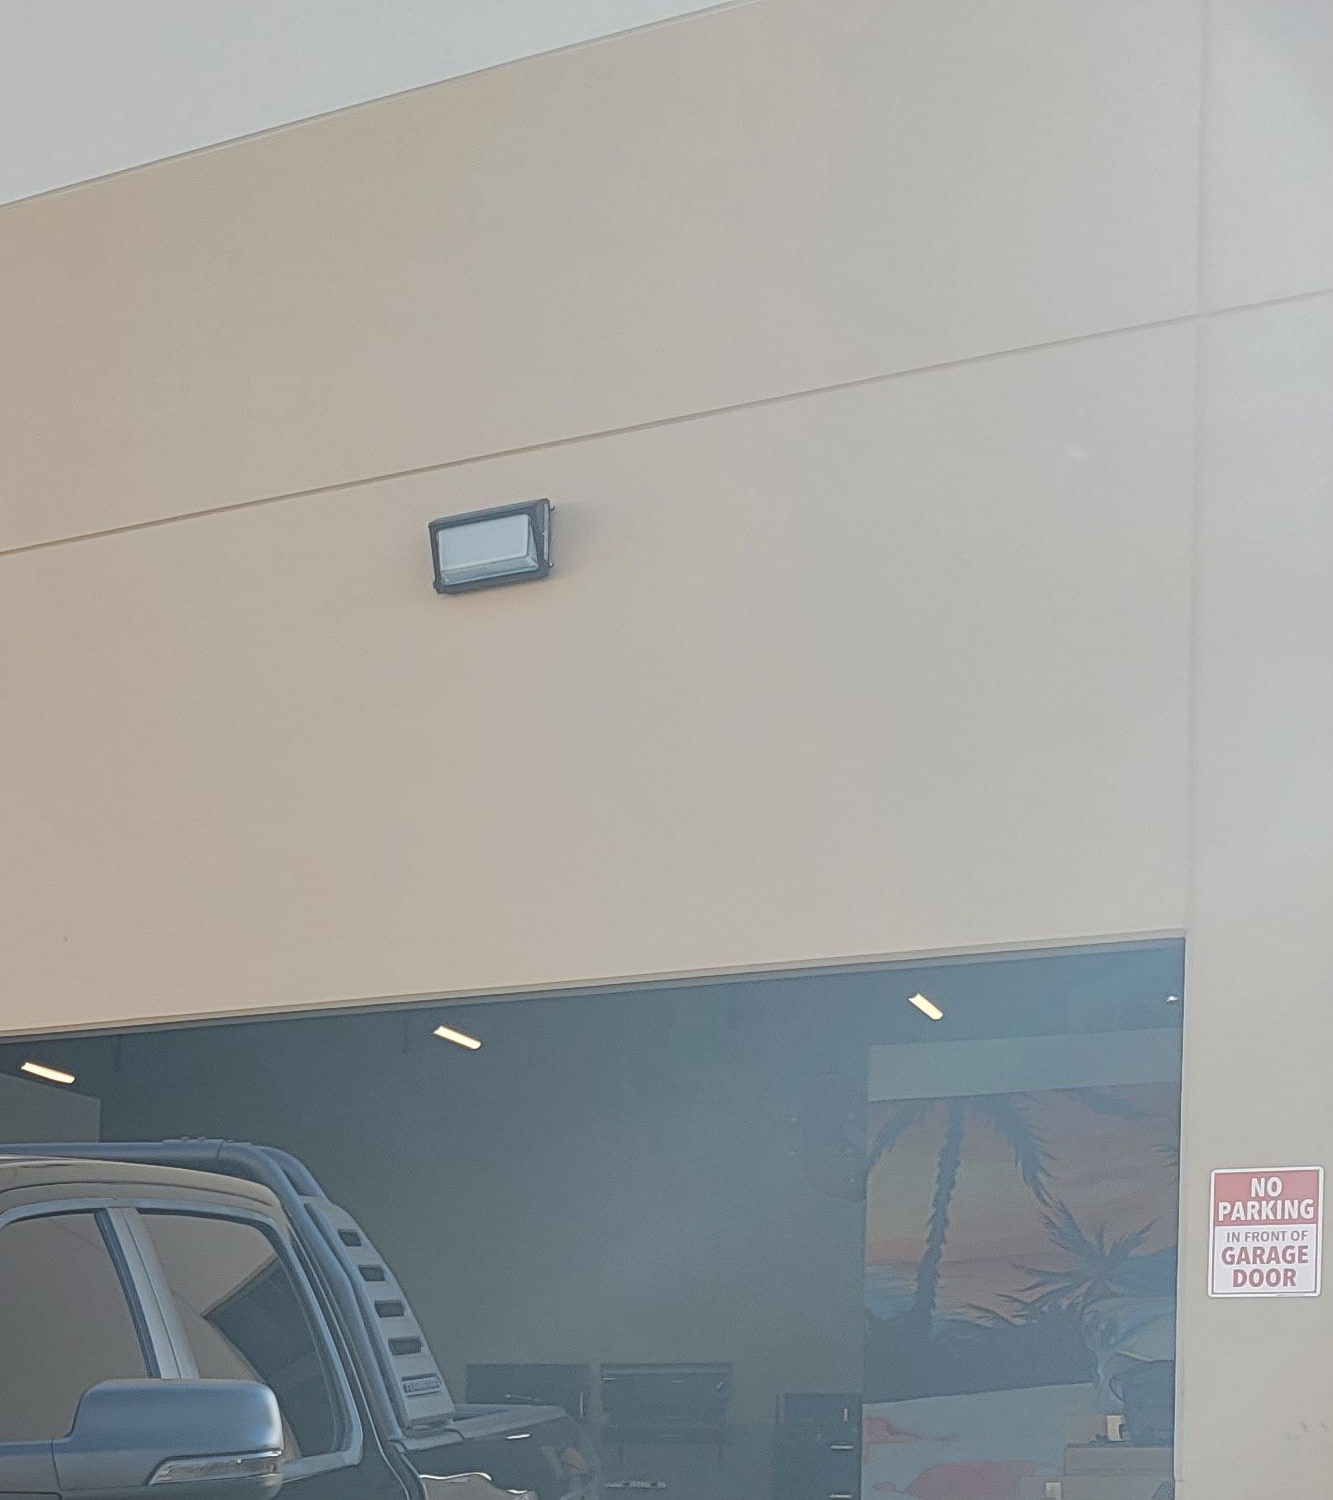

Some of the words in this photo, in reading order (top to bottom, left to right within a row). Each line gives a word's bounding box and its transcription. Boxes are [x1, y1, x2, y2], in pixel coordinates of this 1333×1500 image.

[1250, 1176, 1283, 1198] NO
[1218, 1199, 1315, 1222] PARKING
[1226, 1231, 1240, 1243] IN
[1244, 1230, 1287, 1243] FRONT
[1290, 1230, 1309, 1242] OF
[1221, 1245, 1309, 1266] GARAGE
[1232, 1268, 1297, 1288] DOOR
